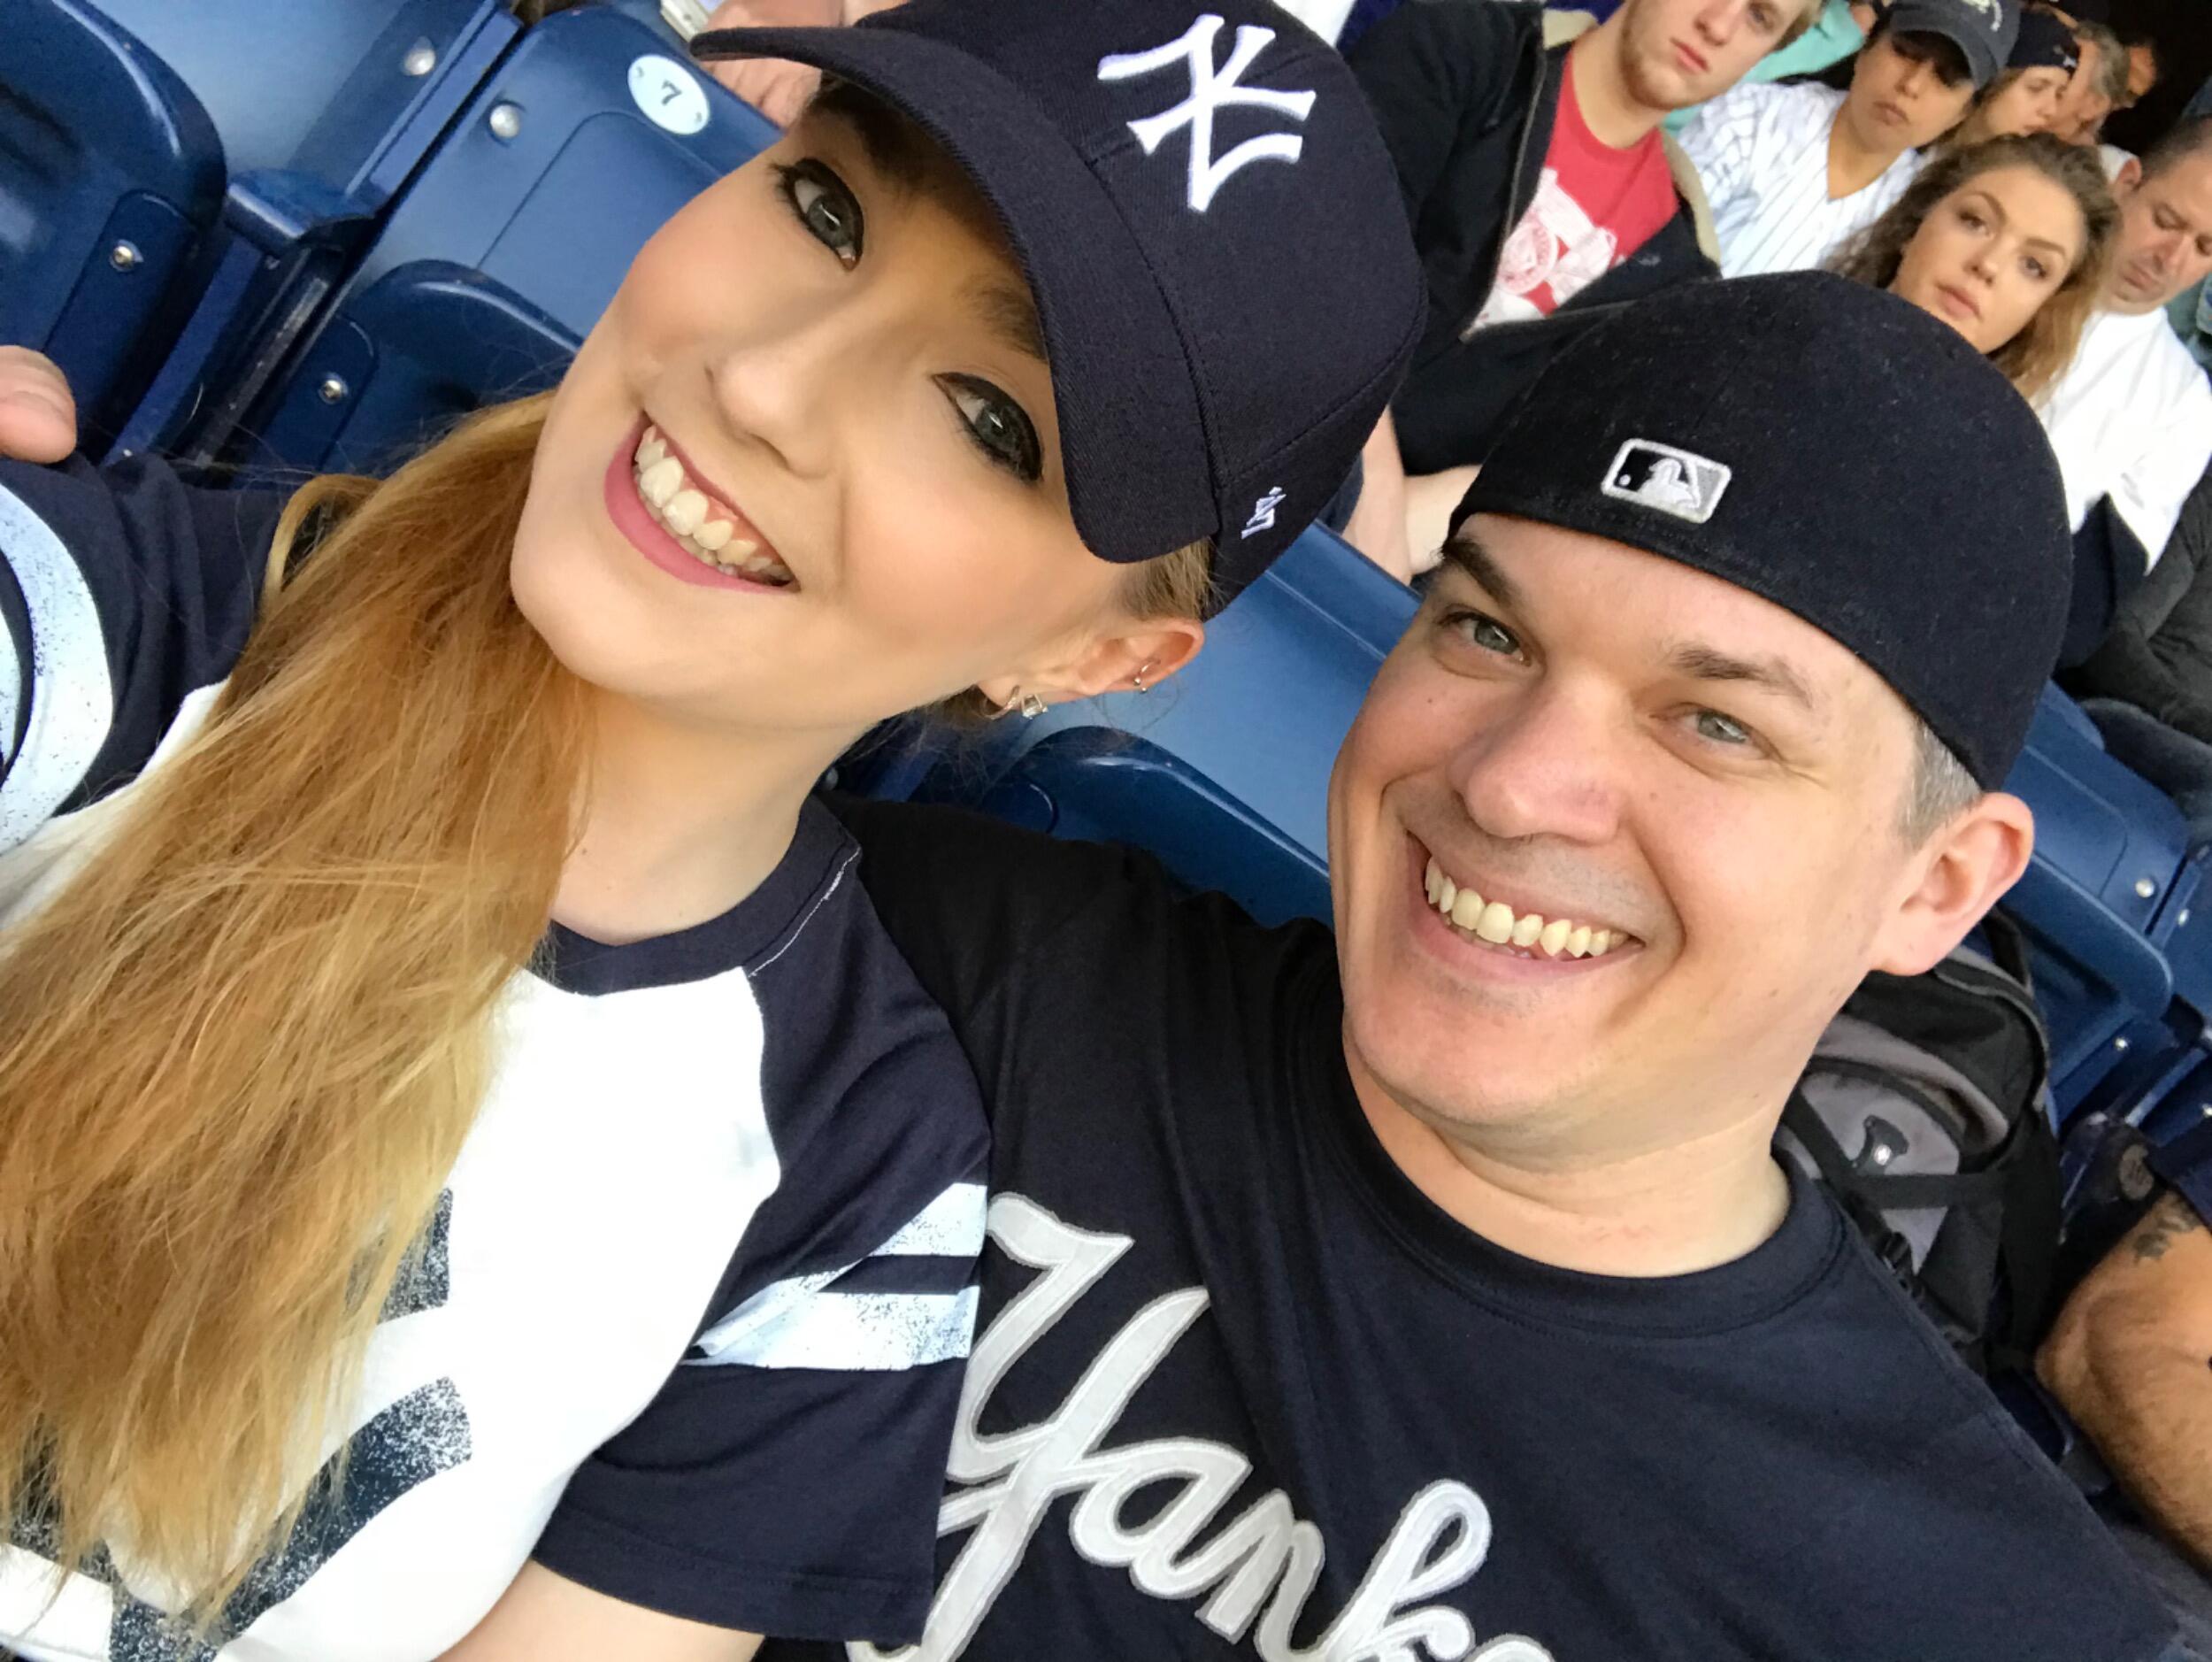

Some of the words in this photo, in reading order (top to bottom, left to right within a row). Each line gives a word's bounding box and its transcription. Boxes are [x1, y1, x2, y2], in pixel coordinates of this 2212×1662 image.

[661, 81, 682, 105] 7
[1097, 13, 1316, 212] NY
[844, 1192, 1555, 1662] Yank
